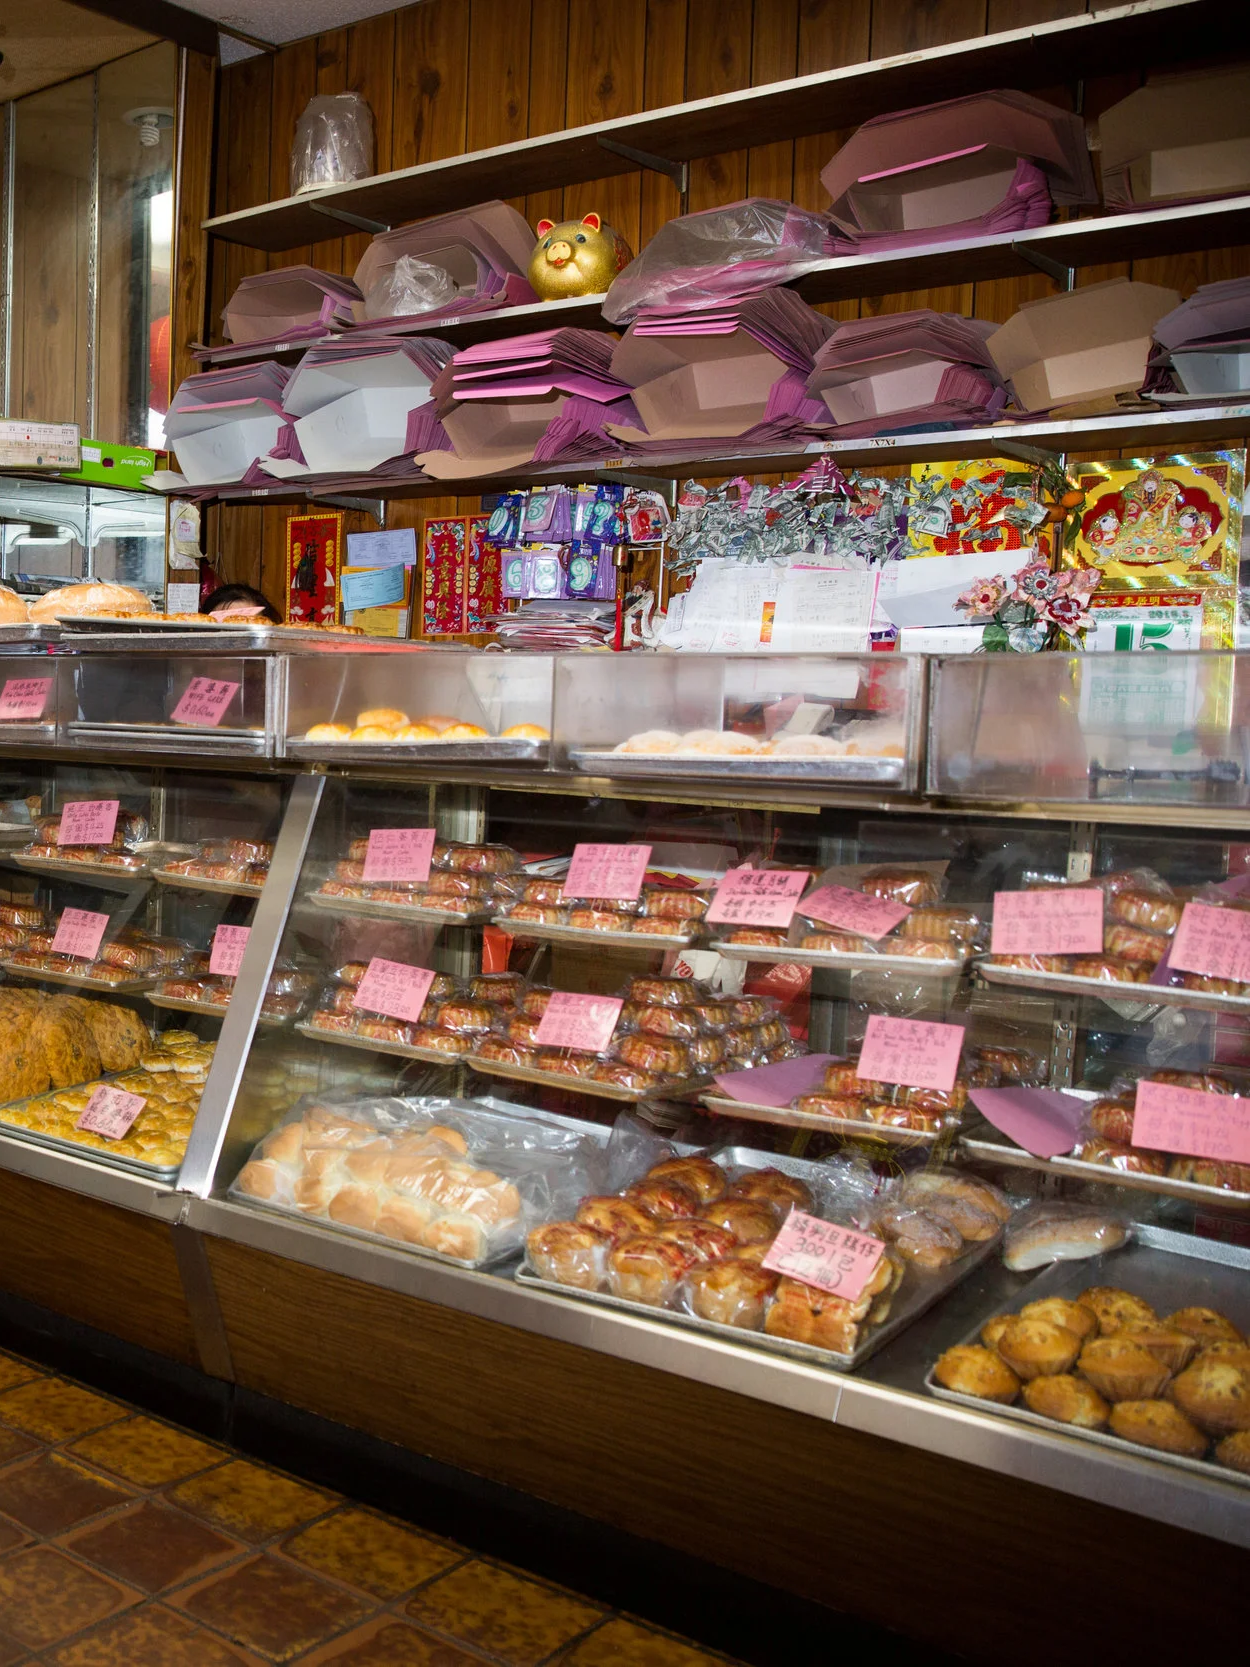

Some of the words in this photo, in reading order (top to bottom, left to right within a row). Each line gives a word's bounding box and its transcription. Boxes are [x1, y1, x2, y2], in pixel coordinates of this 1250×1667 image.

[526, 495, 545, 522] 3
[436, 540, 453, 619] 生意興隆
[506, 559, 522, 588] 6
[569, 558, 593, 591] 9
[1112, 622, 1174, 658] 15
